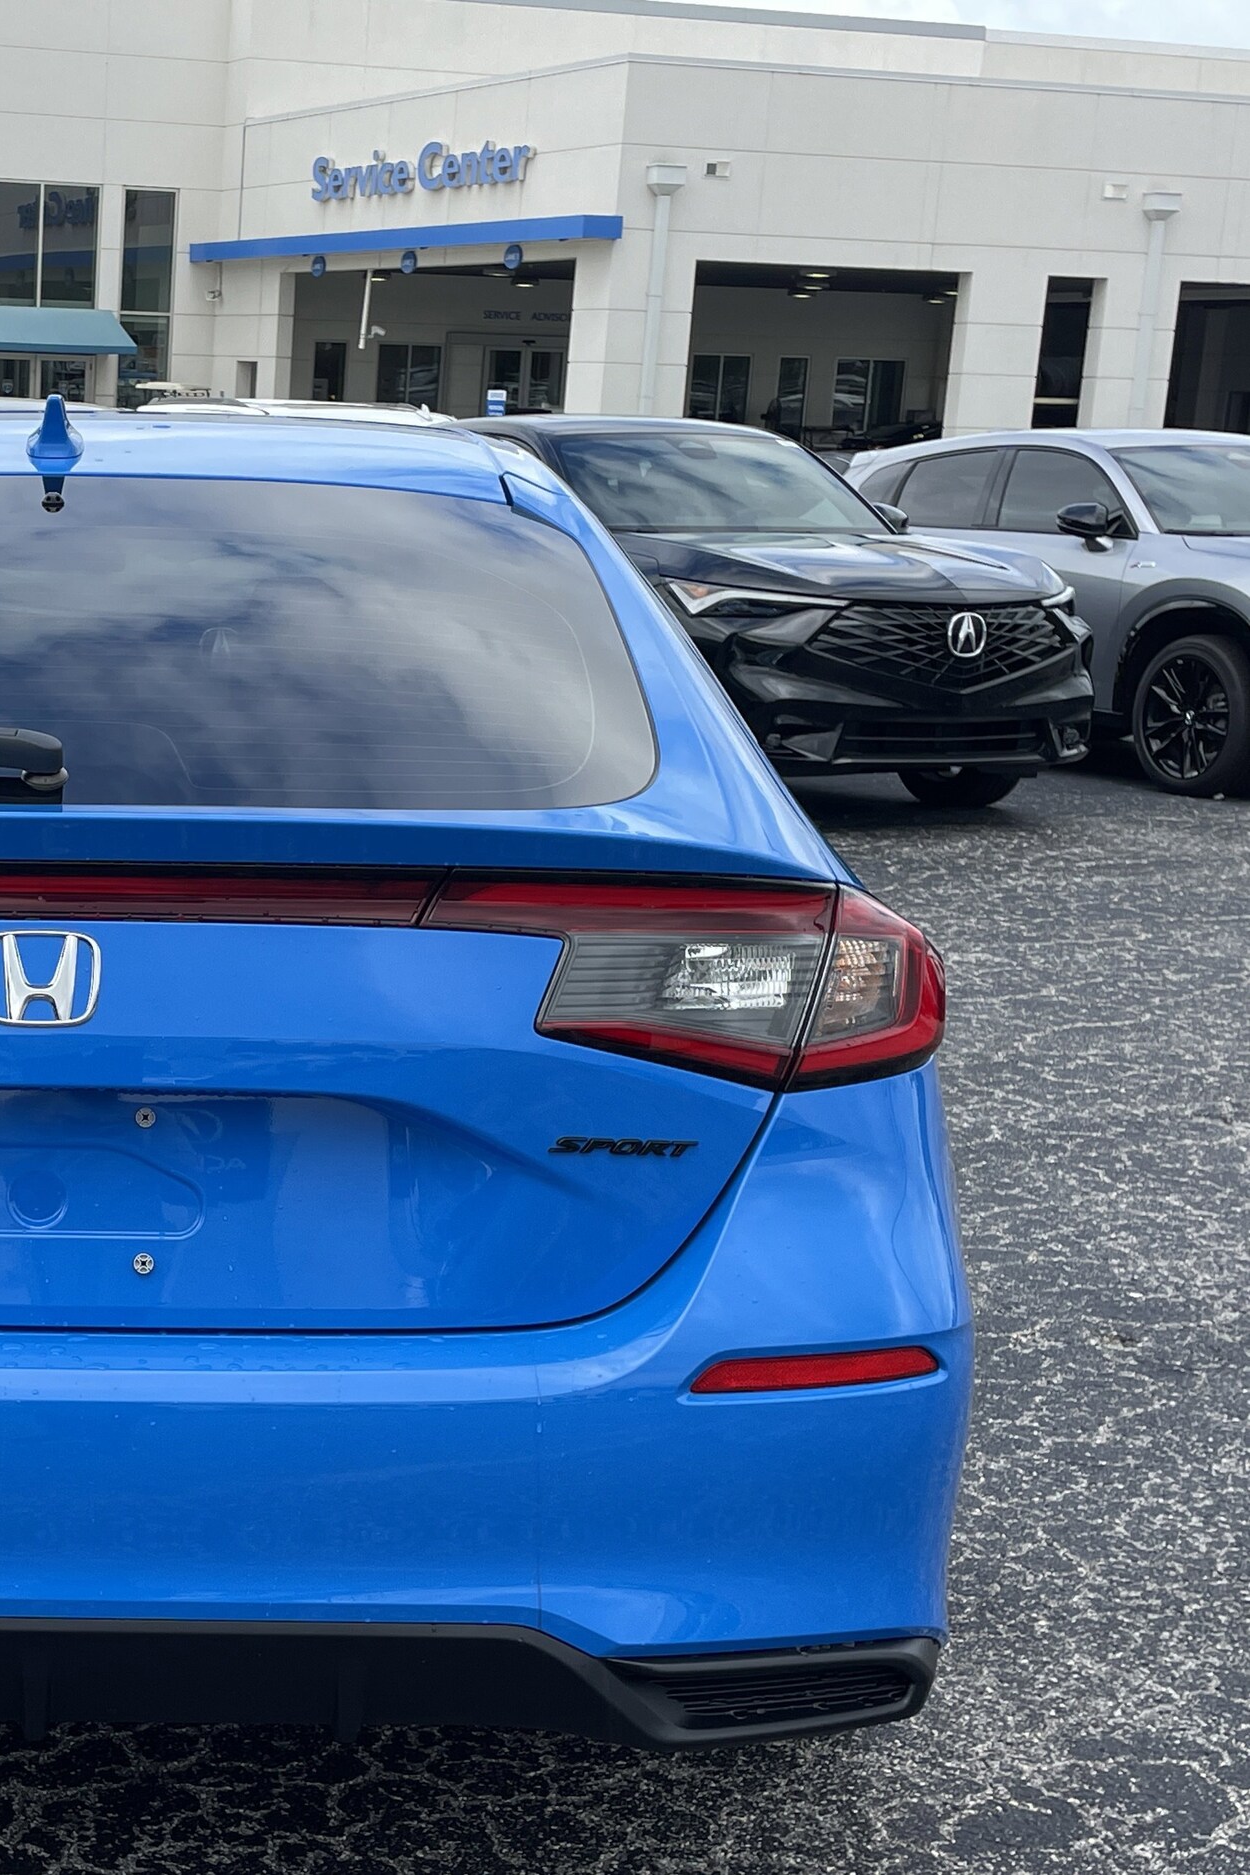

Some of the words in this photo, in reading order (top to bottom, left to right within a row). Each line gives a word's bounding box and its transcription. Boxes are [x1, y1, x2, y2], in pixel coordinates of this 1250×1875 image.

[311, 149, 413, 202] Service
[417, 140, 536, 191] Center
[482, 310, 521, 320] SERVICE
[548, 1136, 699, 1158] SPORT
